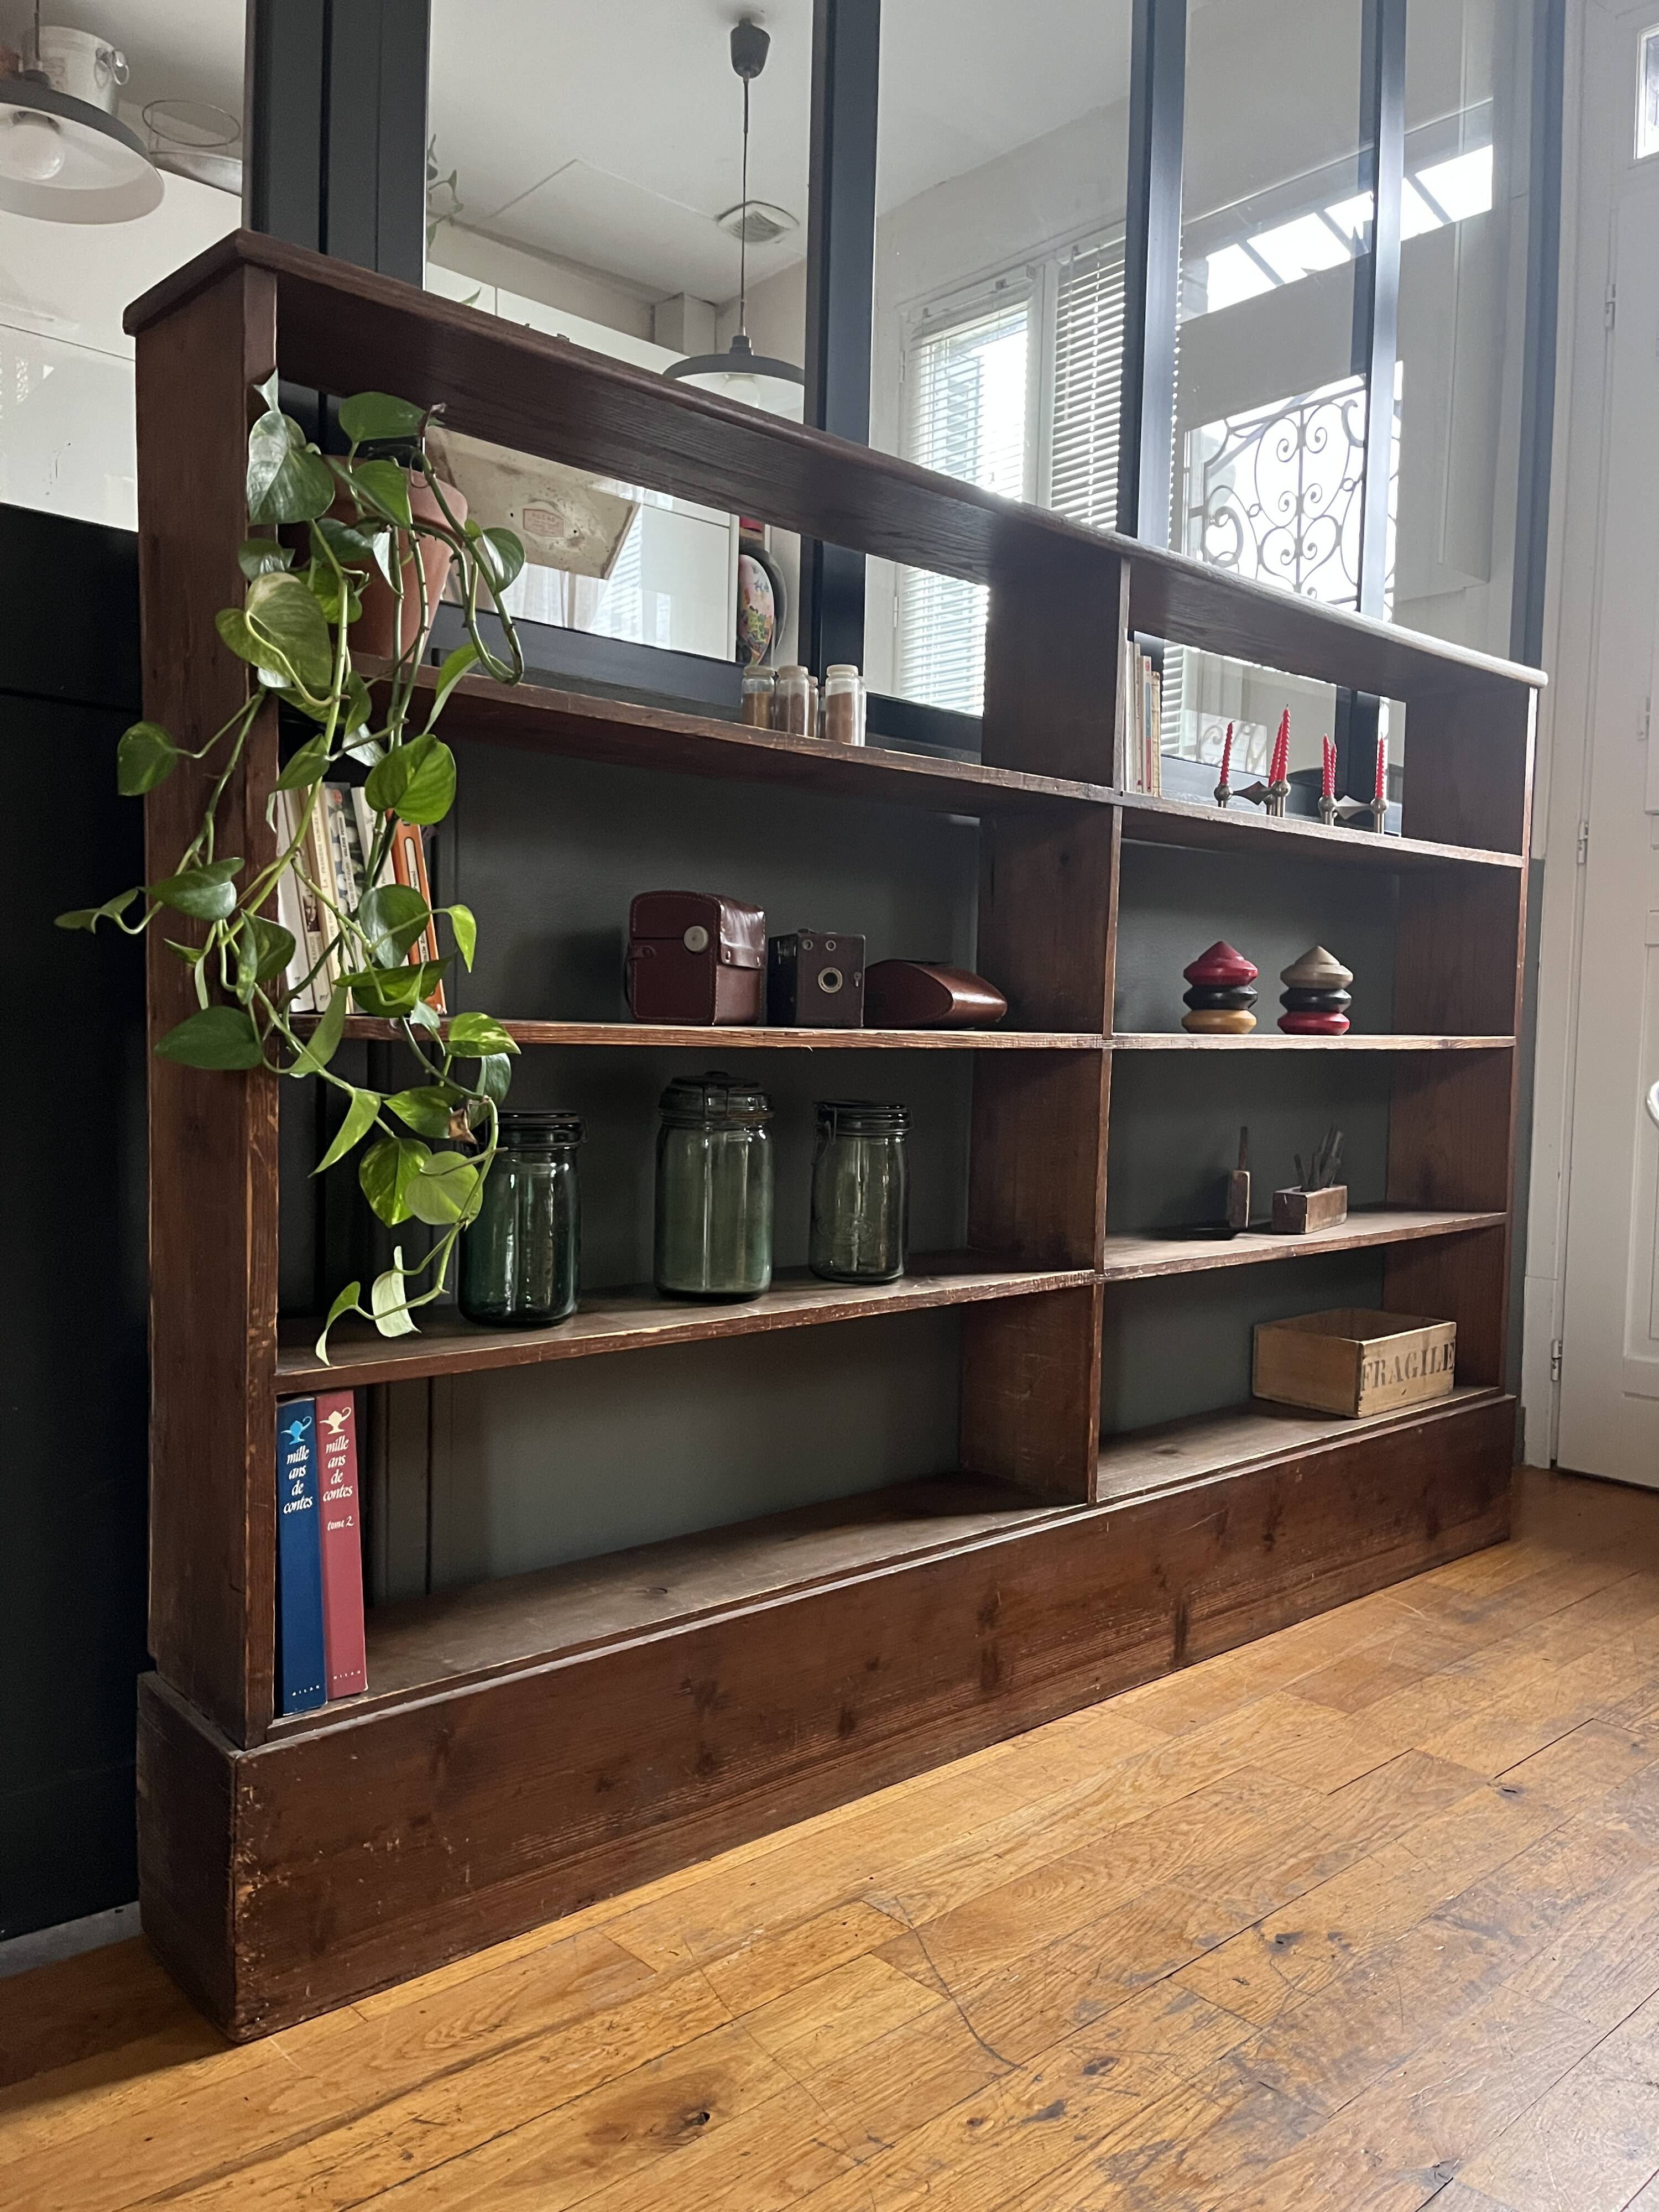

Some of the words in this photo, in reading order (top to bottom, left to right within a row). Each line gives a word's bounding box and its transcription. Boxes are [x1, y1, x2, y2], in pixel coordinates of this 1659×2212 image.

[1361, 1342, 1455, 1391] FRAGILE
[325, 1434, 349, 1454] mille
[286, 1445, 310, 1465] mille
[327, 1454, 346, 1469] ans
[289, 1465, 306, 1480] ans
[331, 1469, 343, 1485] de
[291, 1479, 304, 1496] de
[322, 1484, 353, 1502] contes
[283, 1495, 313, 1514] contes
[327, 1520, 345, 1531] tome
[346, 1515, 354, 1526] 2
